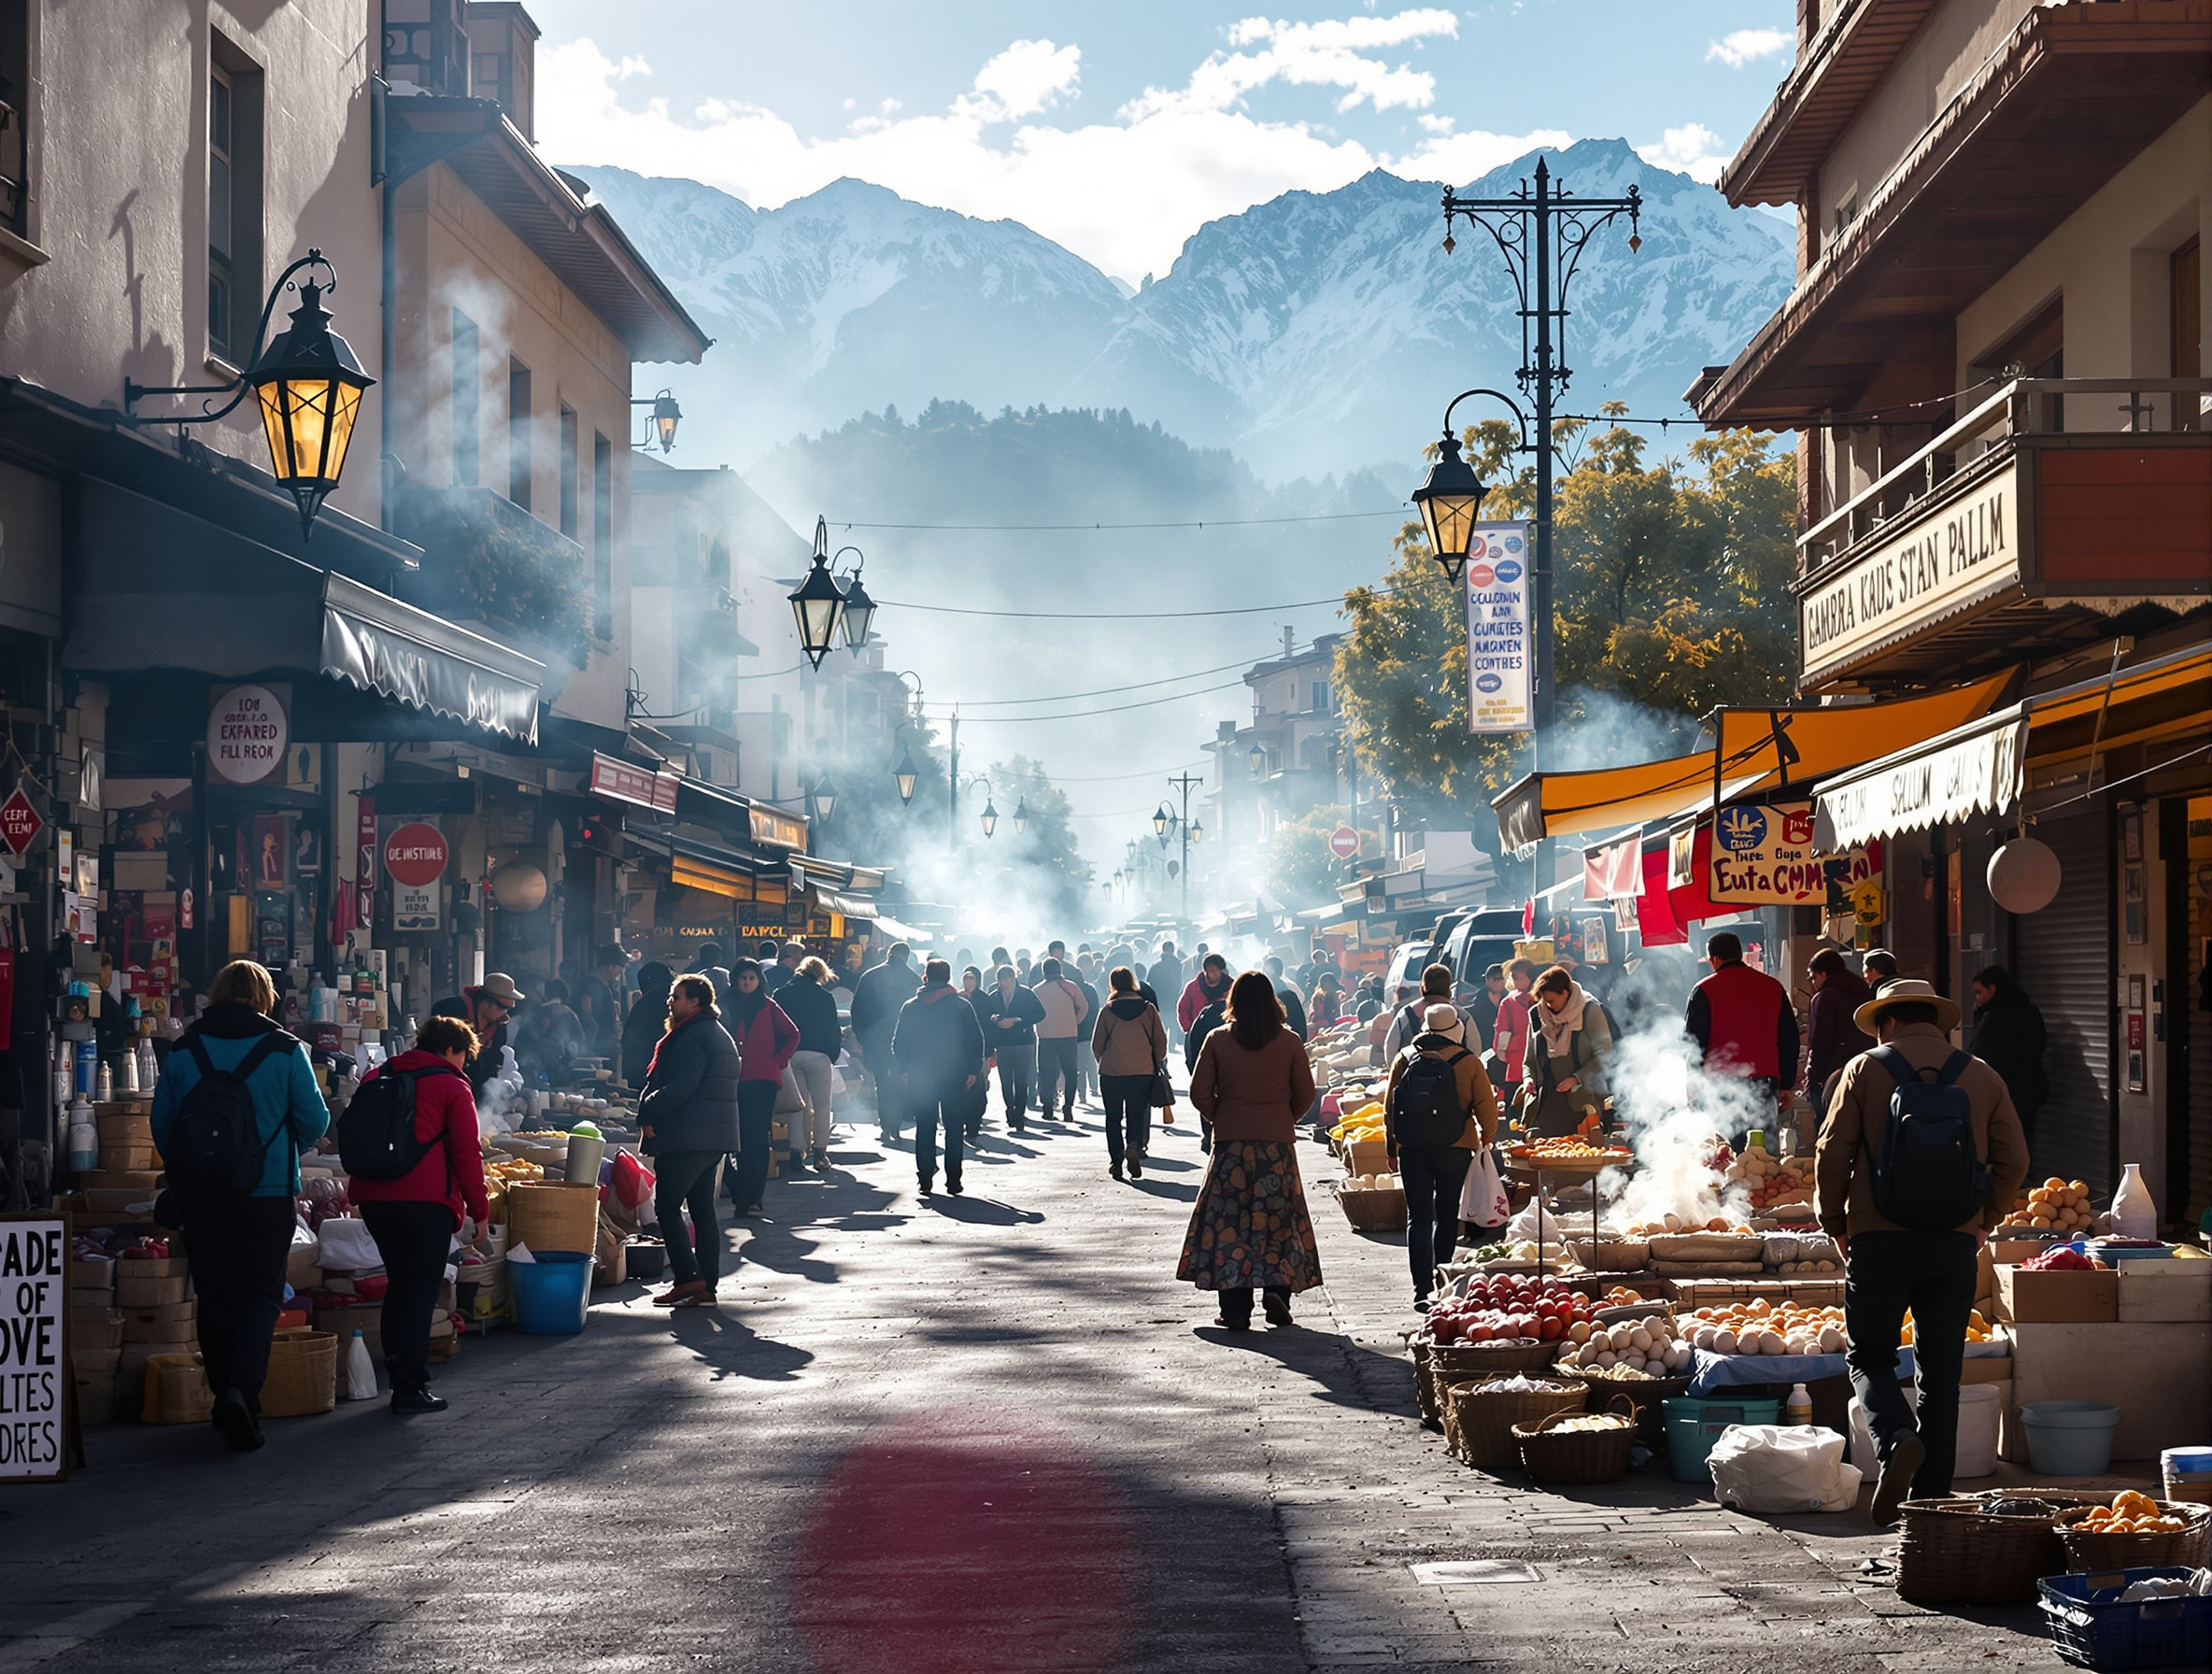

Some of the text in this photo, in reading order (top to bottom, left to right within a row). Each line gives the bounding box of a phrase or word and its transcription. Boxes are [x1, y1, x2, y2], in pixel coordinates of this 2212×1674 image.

[1899, 531, 1940, 604] STAN
[1948, 491, 2006, 577] PALLM
[0, 1230, 62, 1278] ADE
[16, 1281, 50, 1316] OF
